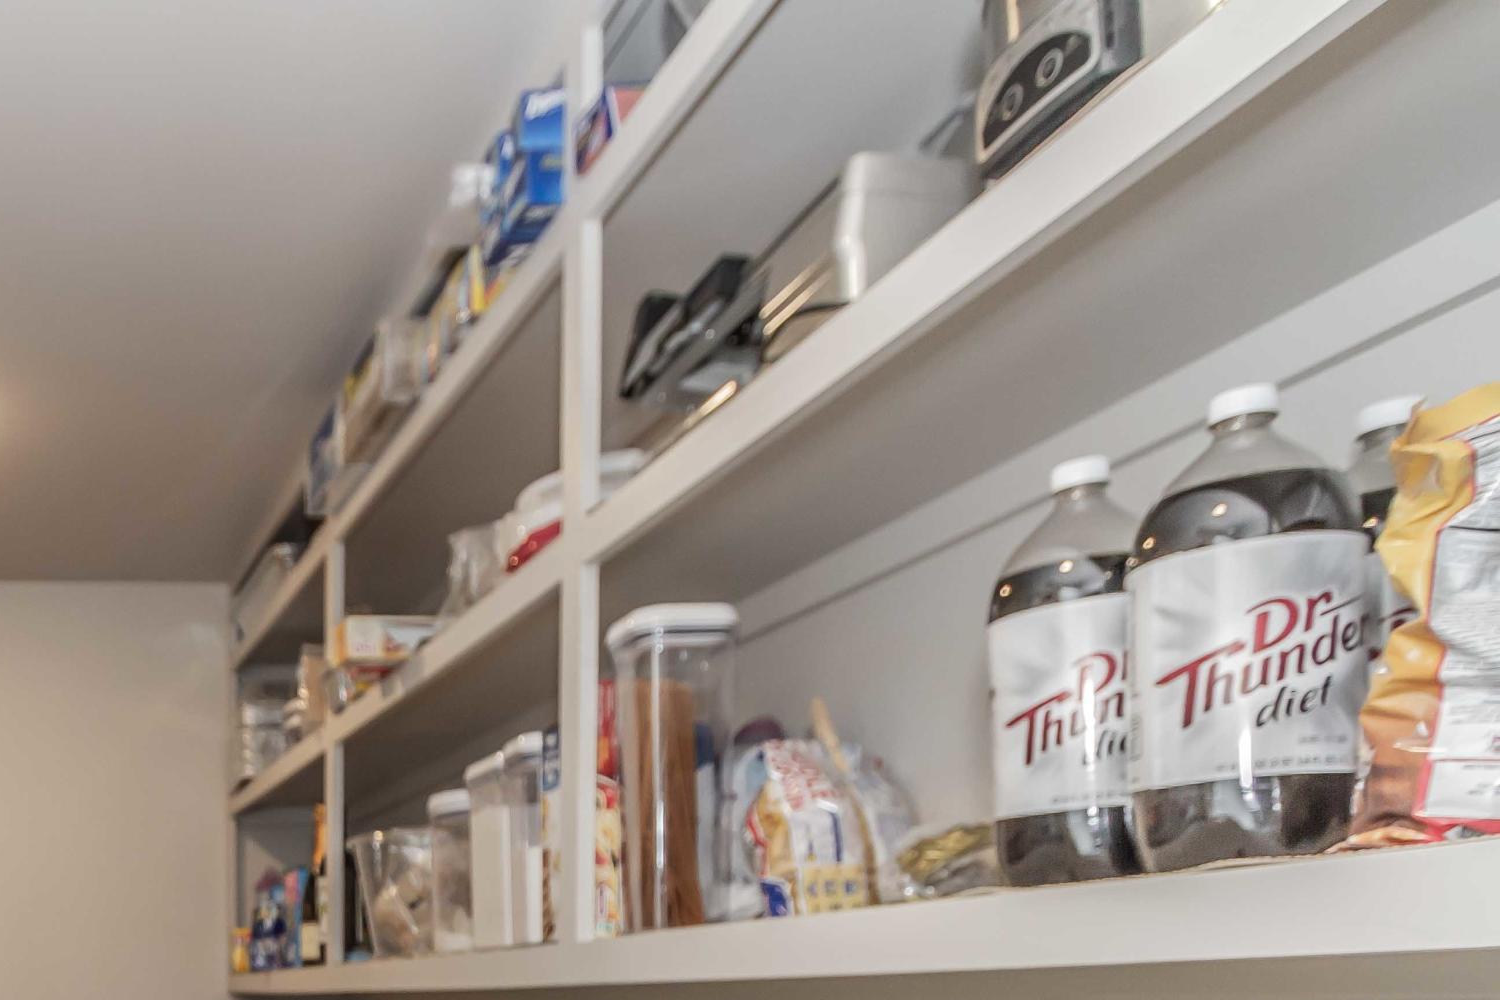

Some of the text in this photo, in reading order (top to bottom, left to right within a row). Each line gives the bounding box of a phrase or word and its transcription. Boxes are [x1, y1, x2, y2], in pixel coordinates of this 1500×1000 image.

[1246, 589, 1334, 653] Dr
[1155, 613, 1370, 728] Thunder
[1255, 675, 1334, 728] diet
